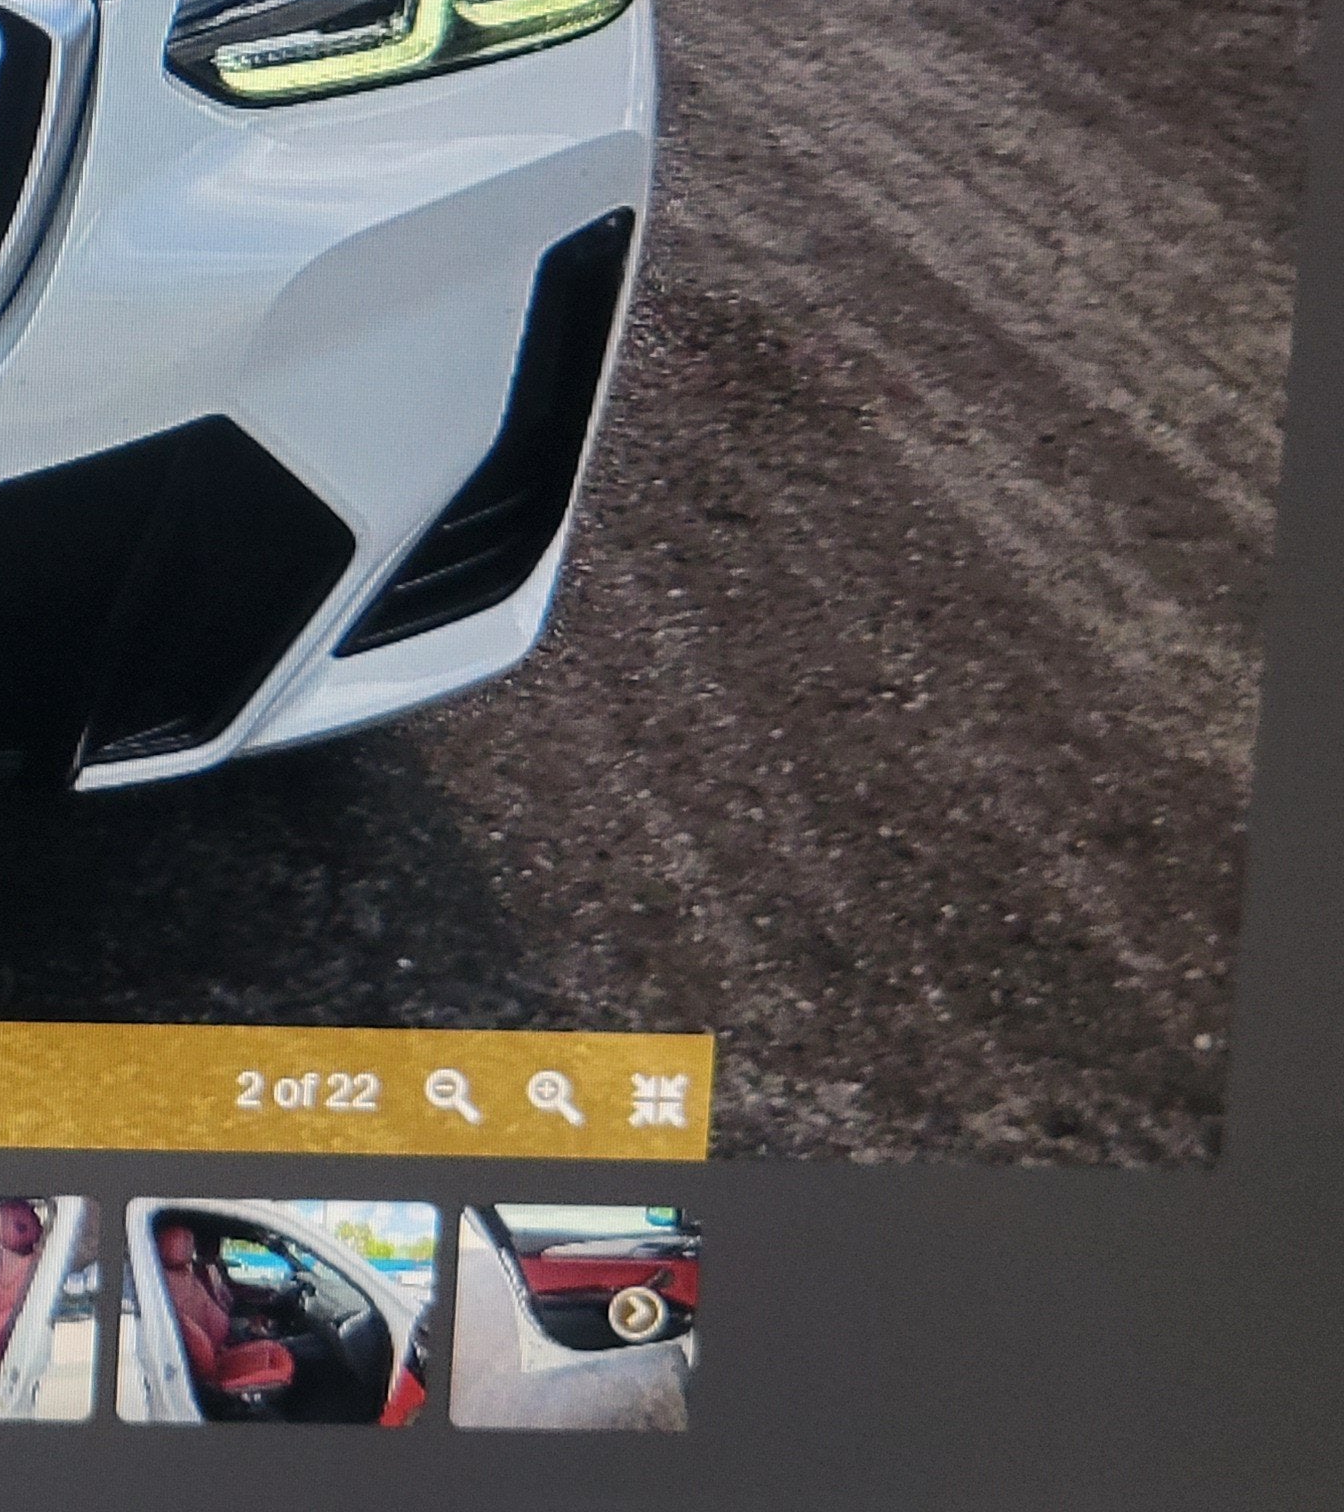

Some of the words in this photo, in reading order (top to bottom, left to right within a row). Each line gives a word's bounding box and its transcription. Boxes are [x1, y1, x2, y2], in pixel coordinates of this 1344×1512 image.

[236, 1071, 264, 1109] 2
[274, 1072, 320, 1109] of
[325, 1073, 380, 1111] 22
